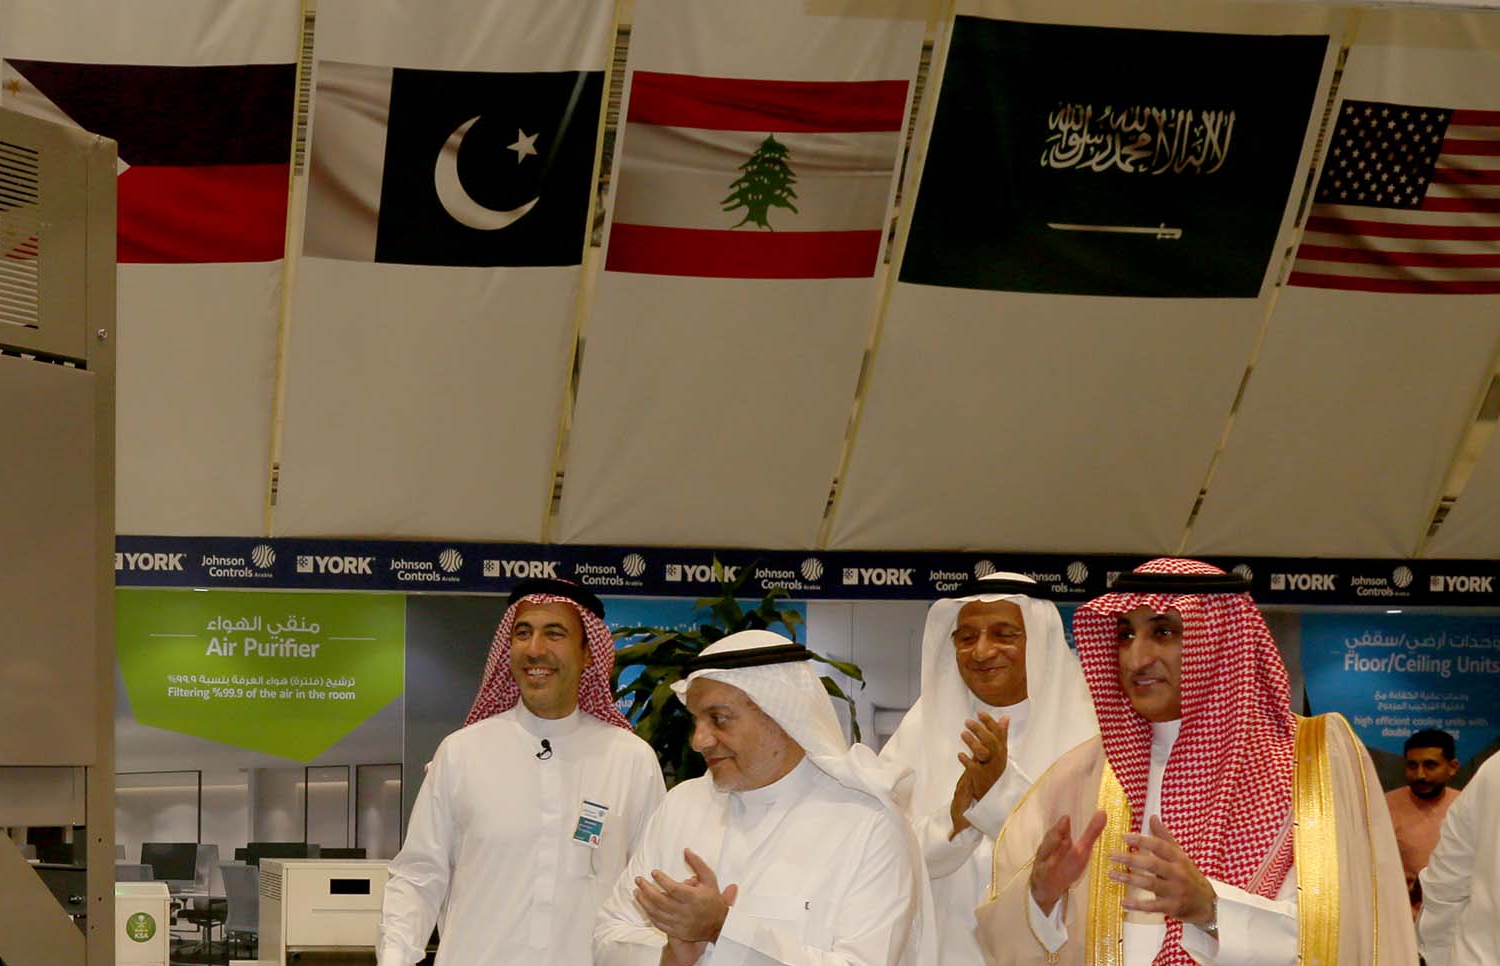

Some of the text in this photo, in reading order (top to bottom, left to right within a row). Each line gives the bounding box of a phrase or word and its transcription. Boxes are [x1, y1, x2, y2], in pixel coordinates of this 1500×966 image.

[127, 552, 184, 572] YORK
[202, 555, 245, 567] Johnson
[315, 556, 373, 575] YORK
[390, 558, 433, 571] Johnson
[209, 566, 253, 578] Controls
[500, 560, 557, 579] YORK
[574, 563, 616, 575] Johnson
[754, 568, 795, 580] Johnson
[397, 570, 441, 582] Controls
[582, 575, 624, 587] Controls
[860, 568, 913, 586] YORK
[929, 570, 968, 581] Johnson
[1351, 576, 1387, 587] Johnson
[936, 581, 963, 592] Cont
[1287, 574, 1336, 590] YORK
[1446, 576, 1493, 592] YORK
[1357, 586, 1394, 597] Controls
[206, 616, 321, 639] منقي الهواء
[205, 637, 321, 658] Air Purifier
[1344, 653, 1500, 678] Floor/Ceiling Units
[167, 686, 355, 700] Filtering %99.9 of the air in the room
[1354, 716, 1373, 728] high
[1375, 716, 1410, 726] efficient
[1412, 717, 1444, 728] cooling
[1445, 717, 1466, 726] units
